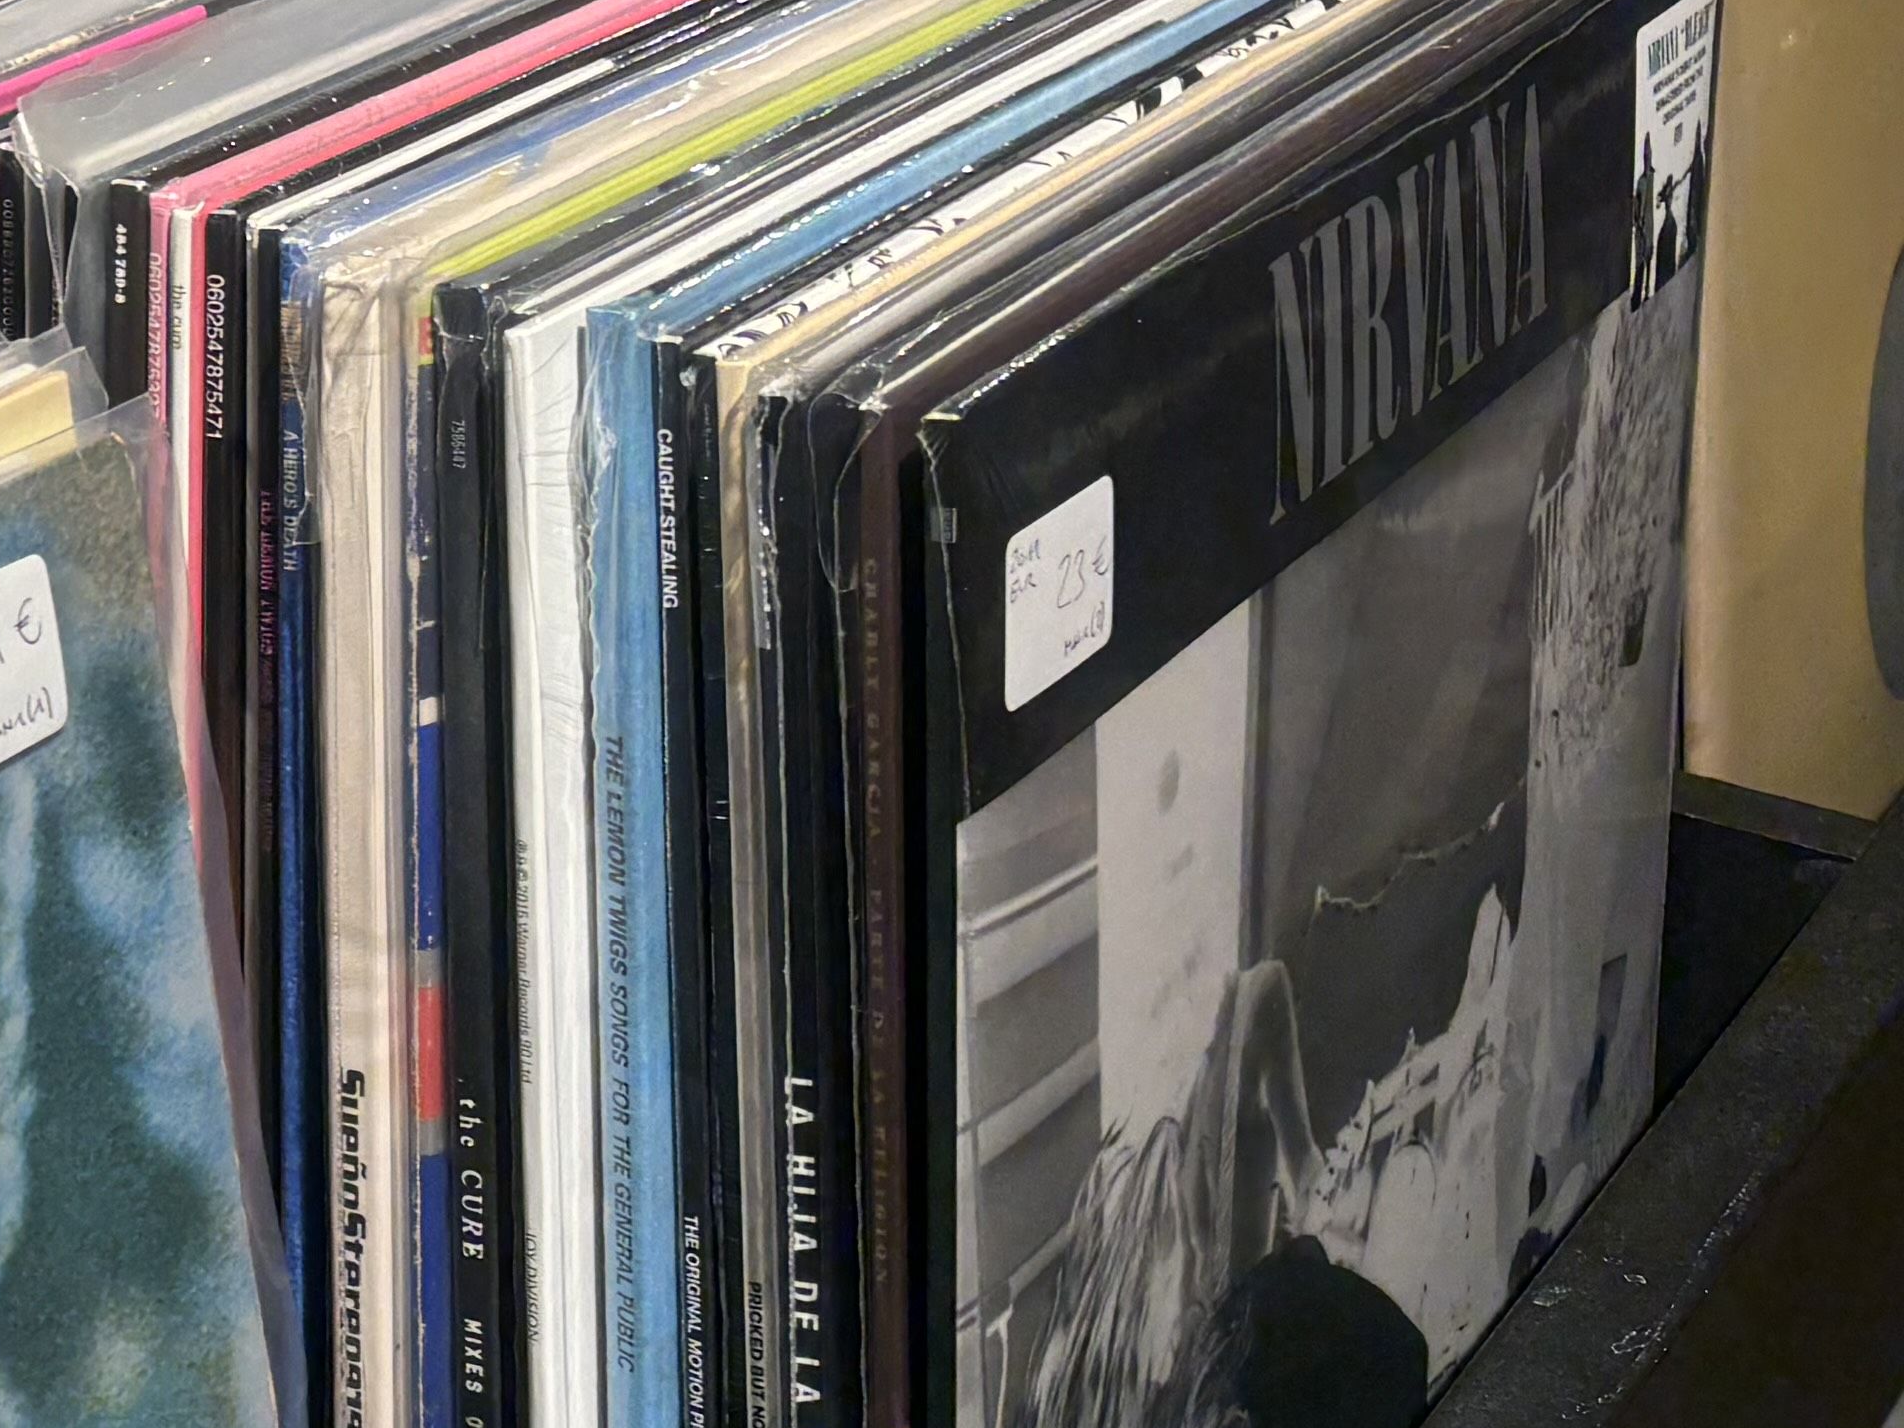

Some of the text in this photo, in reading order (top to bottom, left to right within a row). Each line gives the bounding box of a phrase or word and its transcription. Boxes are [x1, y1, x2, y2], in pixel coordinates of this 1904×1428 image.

[1268, 82, 1549, 526] NIRVANA
[205, 274, 225, 439] 0602547875471
[283, 429, 299, 571] A HERO'S DEATH
[657, 428, 678, 609] CAUGHT STEALING
[13, 597, 42, 646] €
[863, 557, 881, 692] CHARLY
[518, 977, 532, 1036] Records
[605, 735, 636, 1372] THE LEMON TWIGS SONGS FOR THE GENERAL PUBLIC
[458, 1098, 484, 1148] the
[786, 1077, 814, 1125] LA
[460, 1169, 484, 1260] CURE
[684, 1215, 700, 1249] THE
[788, 1154, 817, 1252] HIJA
[524, 1232, 539, 1343] JOY DIVISION
[685, 1252, 702, 1333] ORIGINAL
[748, 1280, 765, 1362] PRICKED
[791, 1280, 820, 1332] DE
[463, 1318, 485, 1394] MIXES
[687, 1337, 704, 1408] MOTION
[750, 1365, 766, 1402] BUT
[791, 1356, 822, 1404] LA
